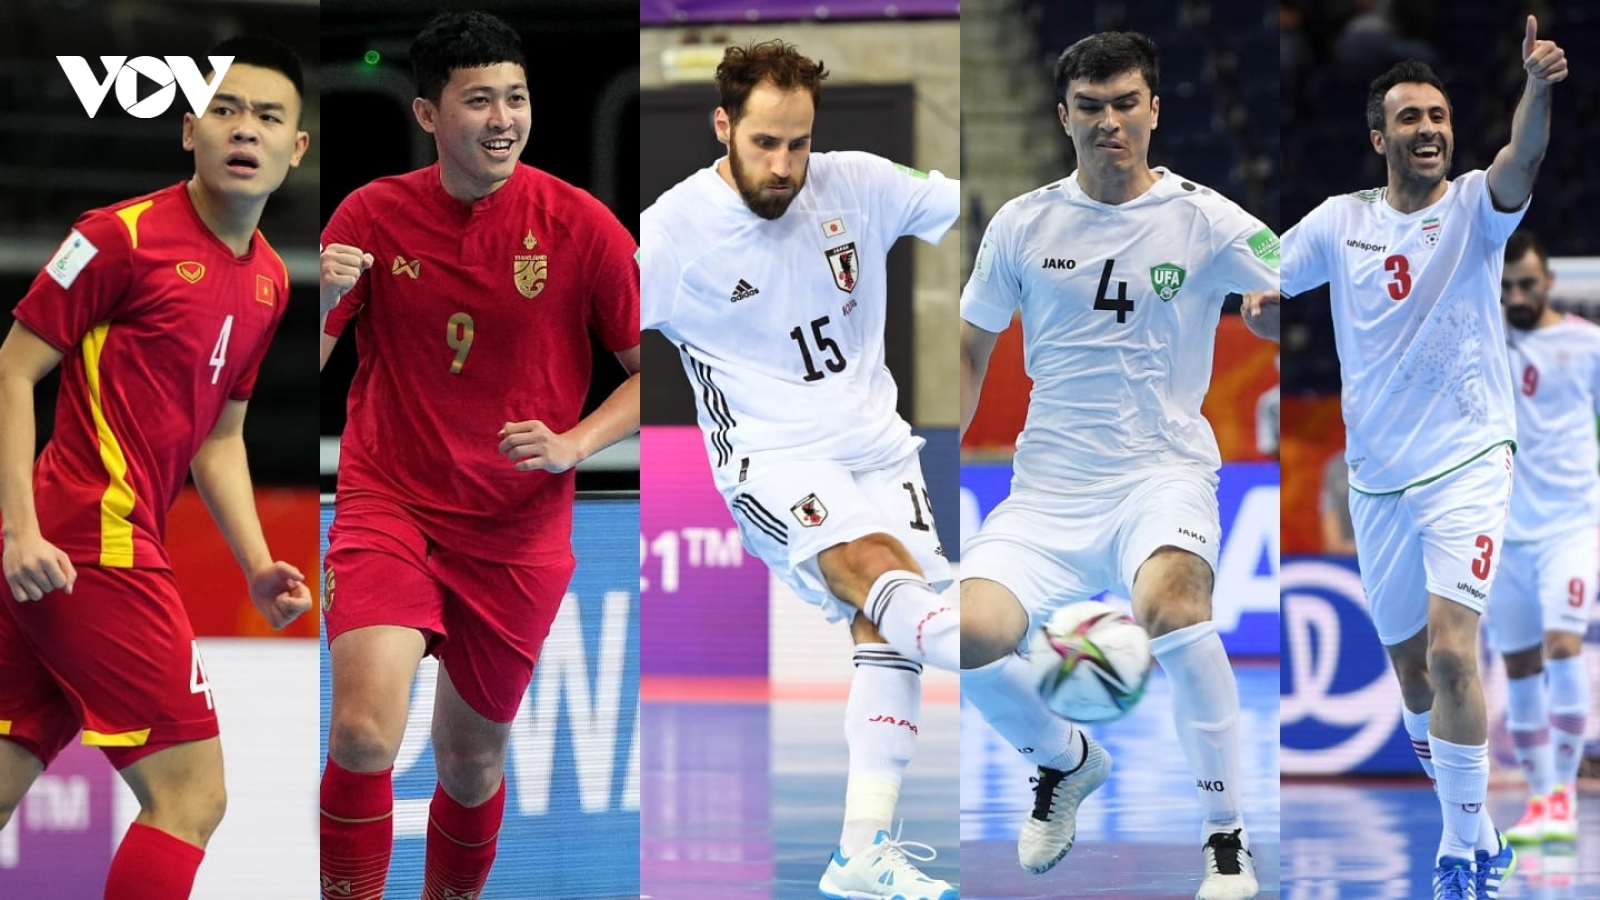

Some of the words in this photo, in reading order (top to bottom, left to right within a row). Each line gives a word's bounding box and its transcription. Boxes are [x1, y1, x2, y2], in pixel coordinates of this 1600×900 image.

[1042, 258, 1076, 270] JAKO
[1347, 239, 1387, 253] uhlsport
[731, 288, 759, 303] adidas
[1093, 259, 1134, 324] 4
[1154, 269, 1180, 286] UFA
[1384, 254, 1412, 301] 3
[209, 315, 234, 385] 4
[446, 312, 474, 374] 9
[790, 315, 847, 382] 15
[1522, 364, 1540, 398] 9
[1178, 527, 1206, 544] JAKO
[1471, 535, 1494, 581] 3
[1567, 577, 1585, 608] 9
[190, 639, 215, 710] 4
